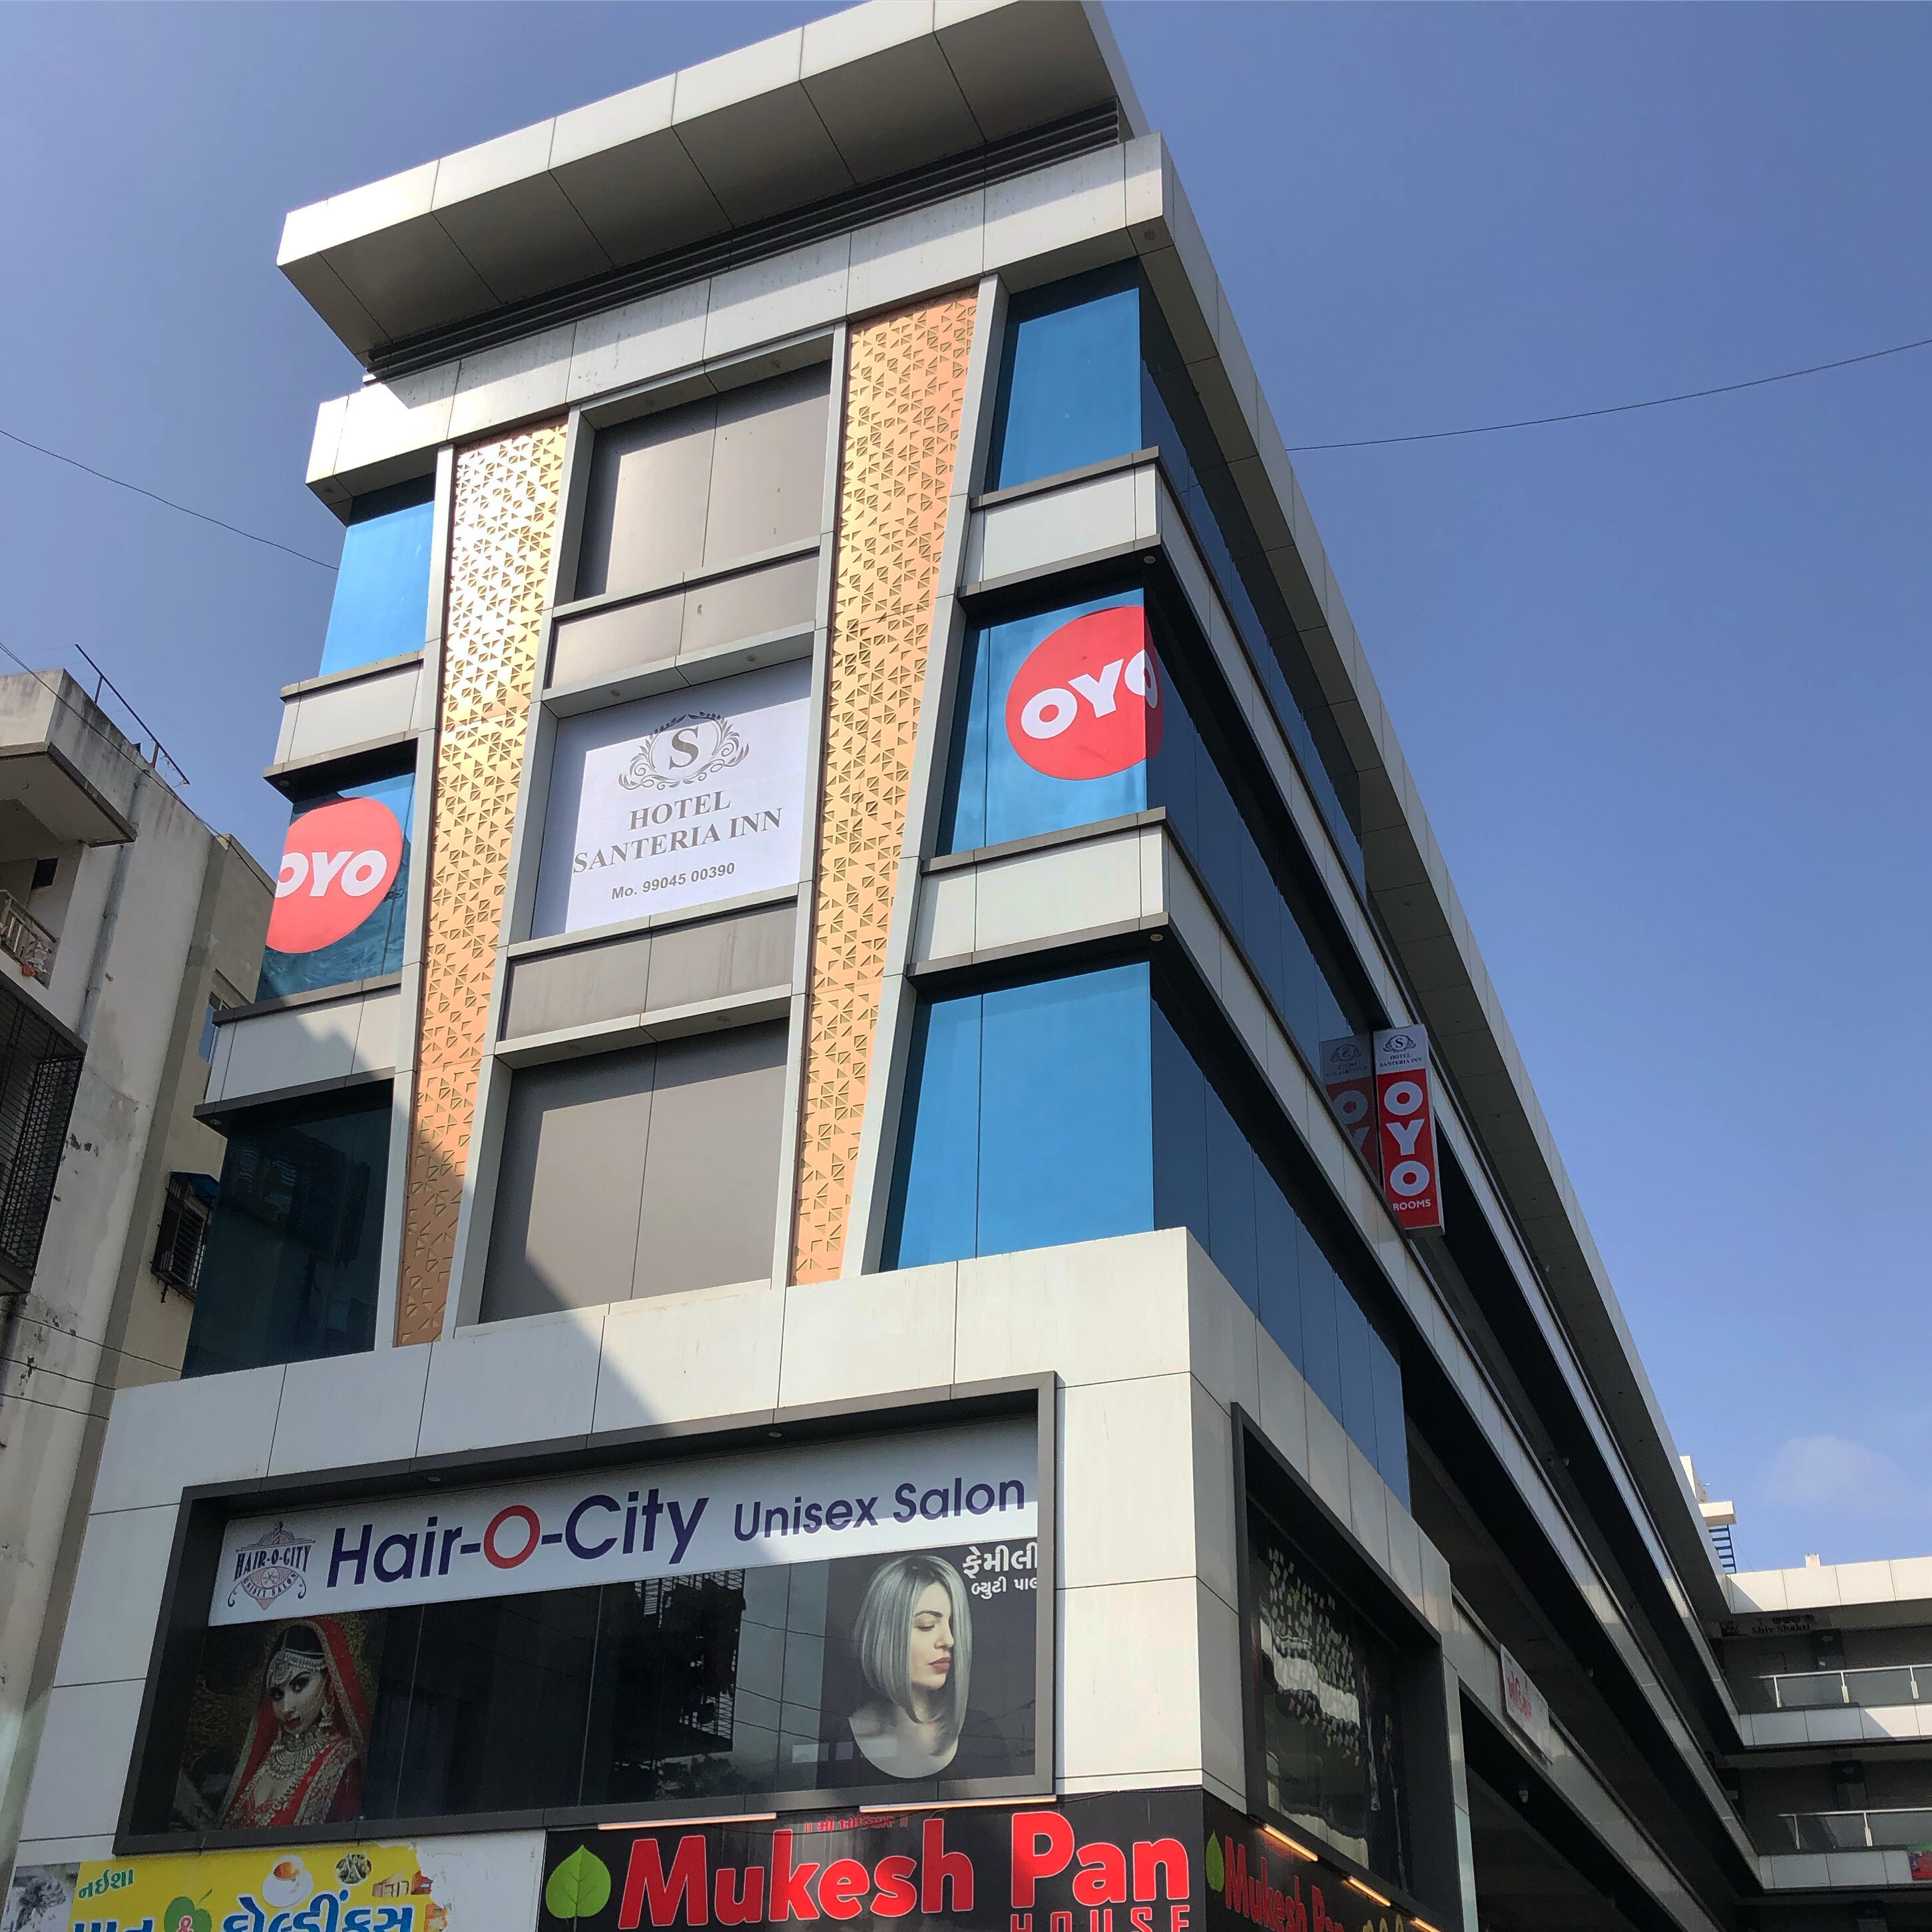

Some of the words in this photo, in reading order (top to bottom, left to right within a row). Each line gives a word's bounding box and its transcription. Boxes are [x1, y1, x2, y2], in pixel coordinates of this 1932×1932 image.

[1021, 650, 1158, 740] OYO
[669, 726, 699, 771] S
[628, 790, 731, 832] HOTEL
[573, 824, 721, 874] SANTERIA
[728, 808, 783, 841] INN
[275, 850, 387, 898] OYO
[611, 885, 638, 900] Mo.
[642, 873, 686, 894] 99045
[691, 863, 736, 883] 00390
[1392, 1199, 1431, 1211] ROOMS
[326, 1489, 710, 1588] Hair-O-City
[734, 1497, 879, 1542] Unisex
[893, 1477, 1025, 1524] Salon
[234, 1545, 312, 1582] HAIR-O-CITY
[618, 1818, 973, 1929] Mukesh
[1011, 1811, 1190, 1908] Pan
[1225, 1836, 1308, 1932] Mukesh
